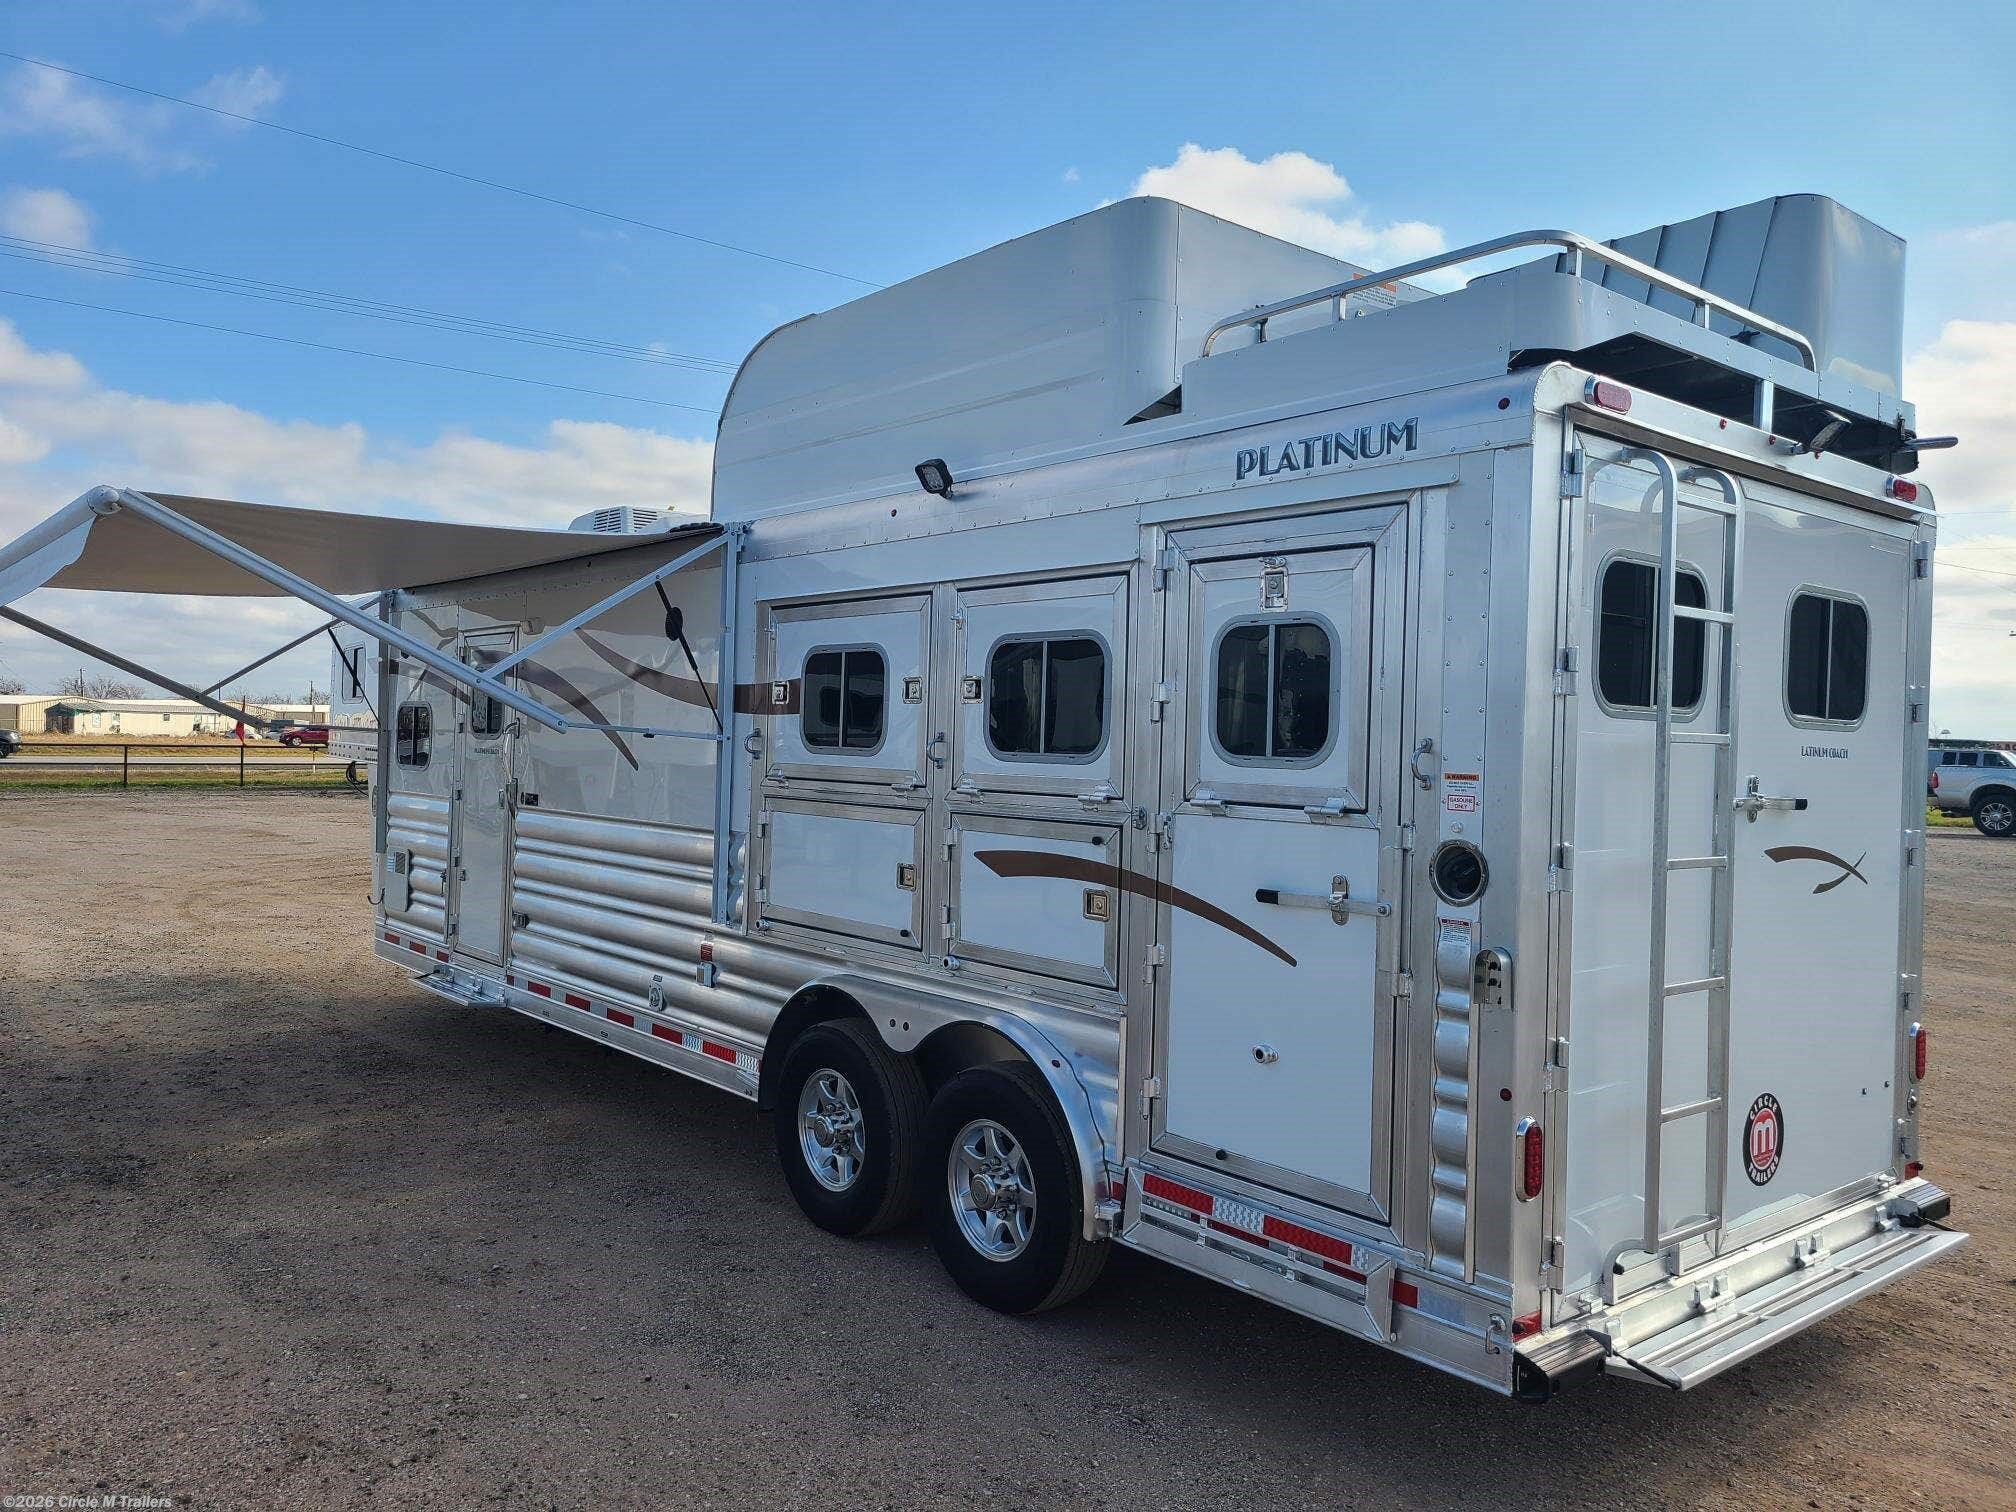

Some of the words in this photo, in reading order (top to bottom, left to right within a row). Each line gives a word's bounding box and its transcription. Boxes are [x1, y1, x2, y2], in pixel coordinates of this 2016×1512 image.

[1236, 416, 1419, 481] PLATINUM
[1749, 1095, 1778, 1120] CIRCLE
[1748, 1155, 1779, 1183] TRAILERS
